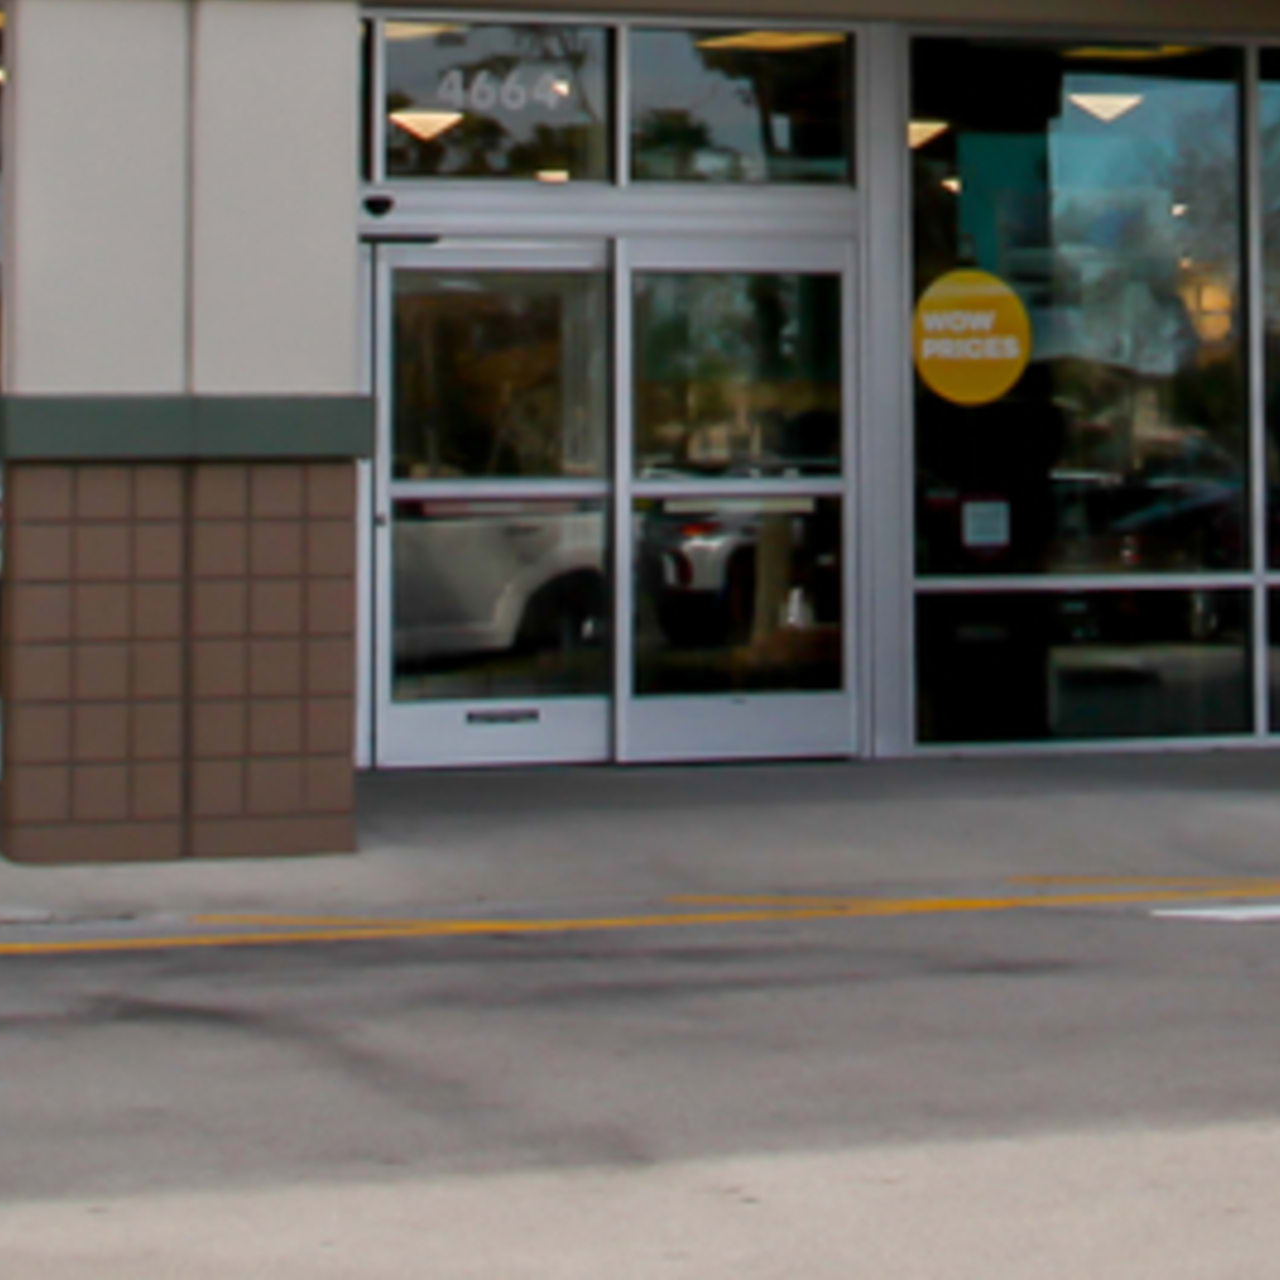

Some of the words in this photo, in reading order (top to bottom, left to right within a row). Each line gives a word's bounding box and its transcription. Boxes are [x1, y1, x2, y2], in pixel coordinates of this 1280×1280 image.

[437, 69, 562, 110] 4664
[922, 310, 996, 332] WOW
[922, 335, 1020, 359] PRICES
